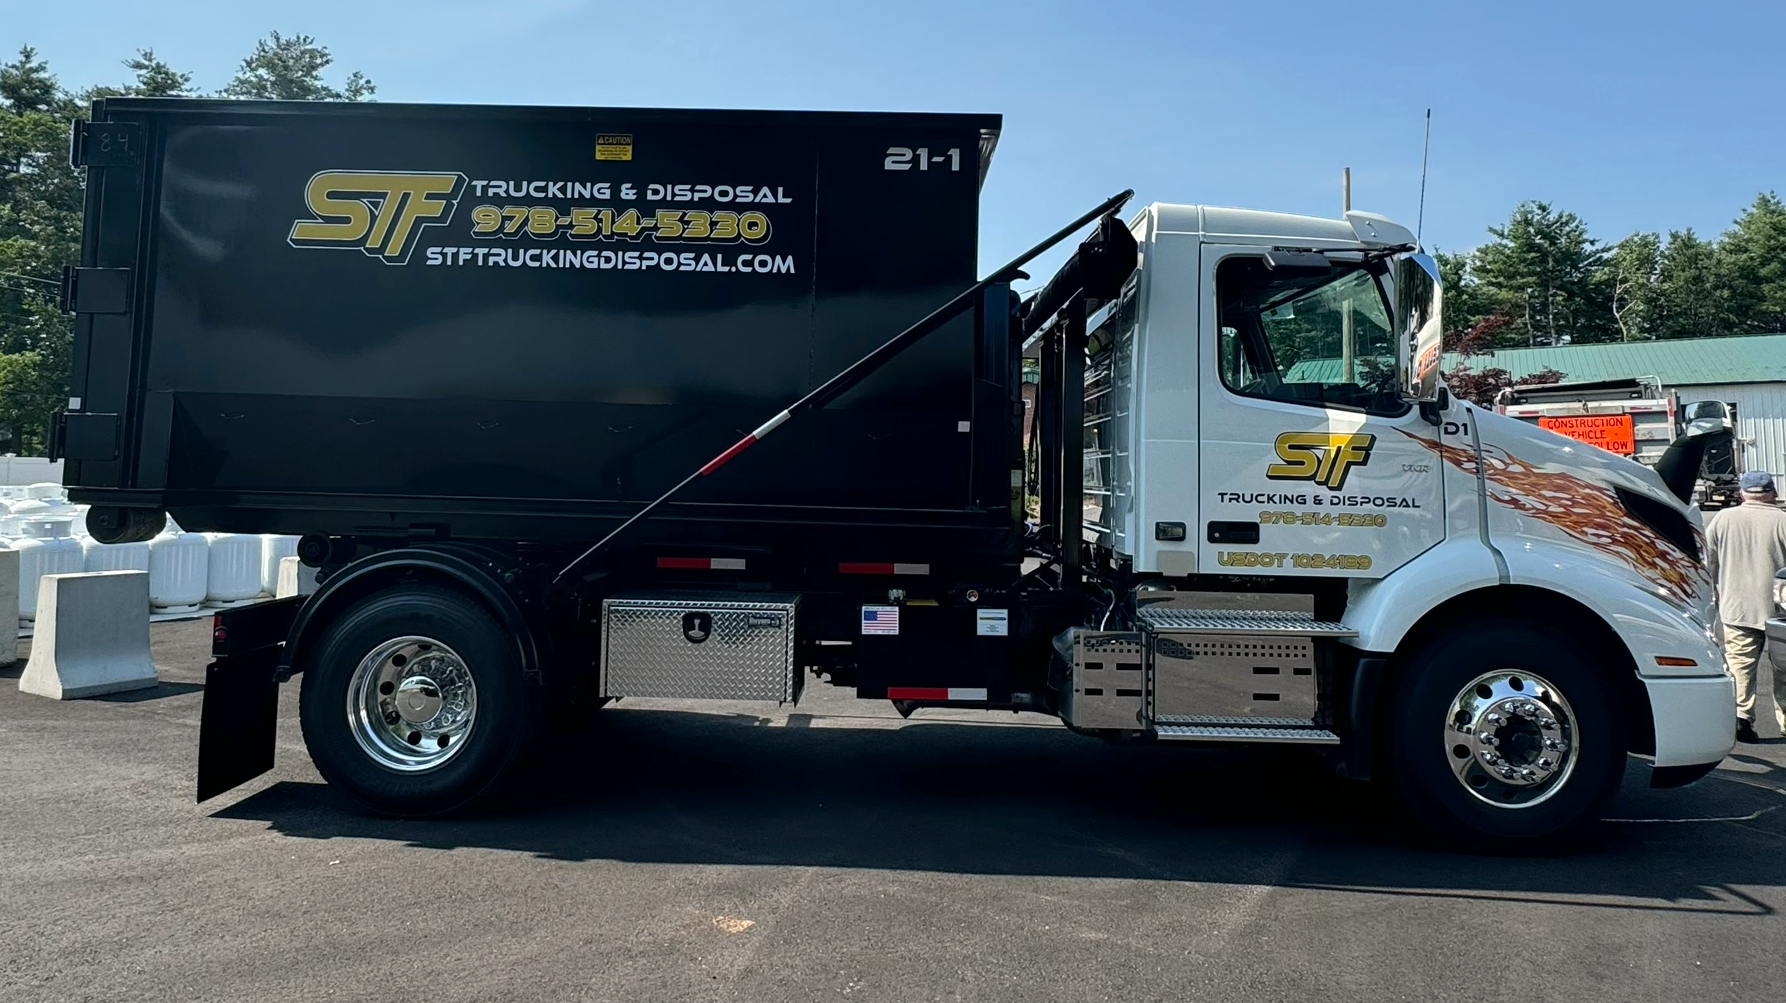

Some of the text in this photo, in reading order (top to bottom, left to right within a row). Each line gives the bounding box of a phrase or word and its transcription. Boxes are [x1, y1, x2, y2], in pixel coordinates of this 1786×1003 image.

[604, 136, 631, 145] CAUTION
[884, 146, 961, 171] 21-1
[470, 179, 793, 204] TRUCKING & DISPOSAL
[287, 169, 469, 265] STF
[471, 205, 772, 245] 978-514-5330
[425, 246, 795, 275] STFTRUCKINGDISPOSAL.COM
[1443, 421, 1469, 436] D1
[1547, 417, 1624, 430] CONSTRUCTION
[1265, 431, 1377, 491] STF
[1217, 492, 1422, 509] TRUCKING & DISPOSAL
[1258, 510, 1388, 528] 978-514-5330
[1217, 551, 1289, 568] USDOT
